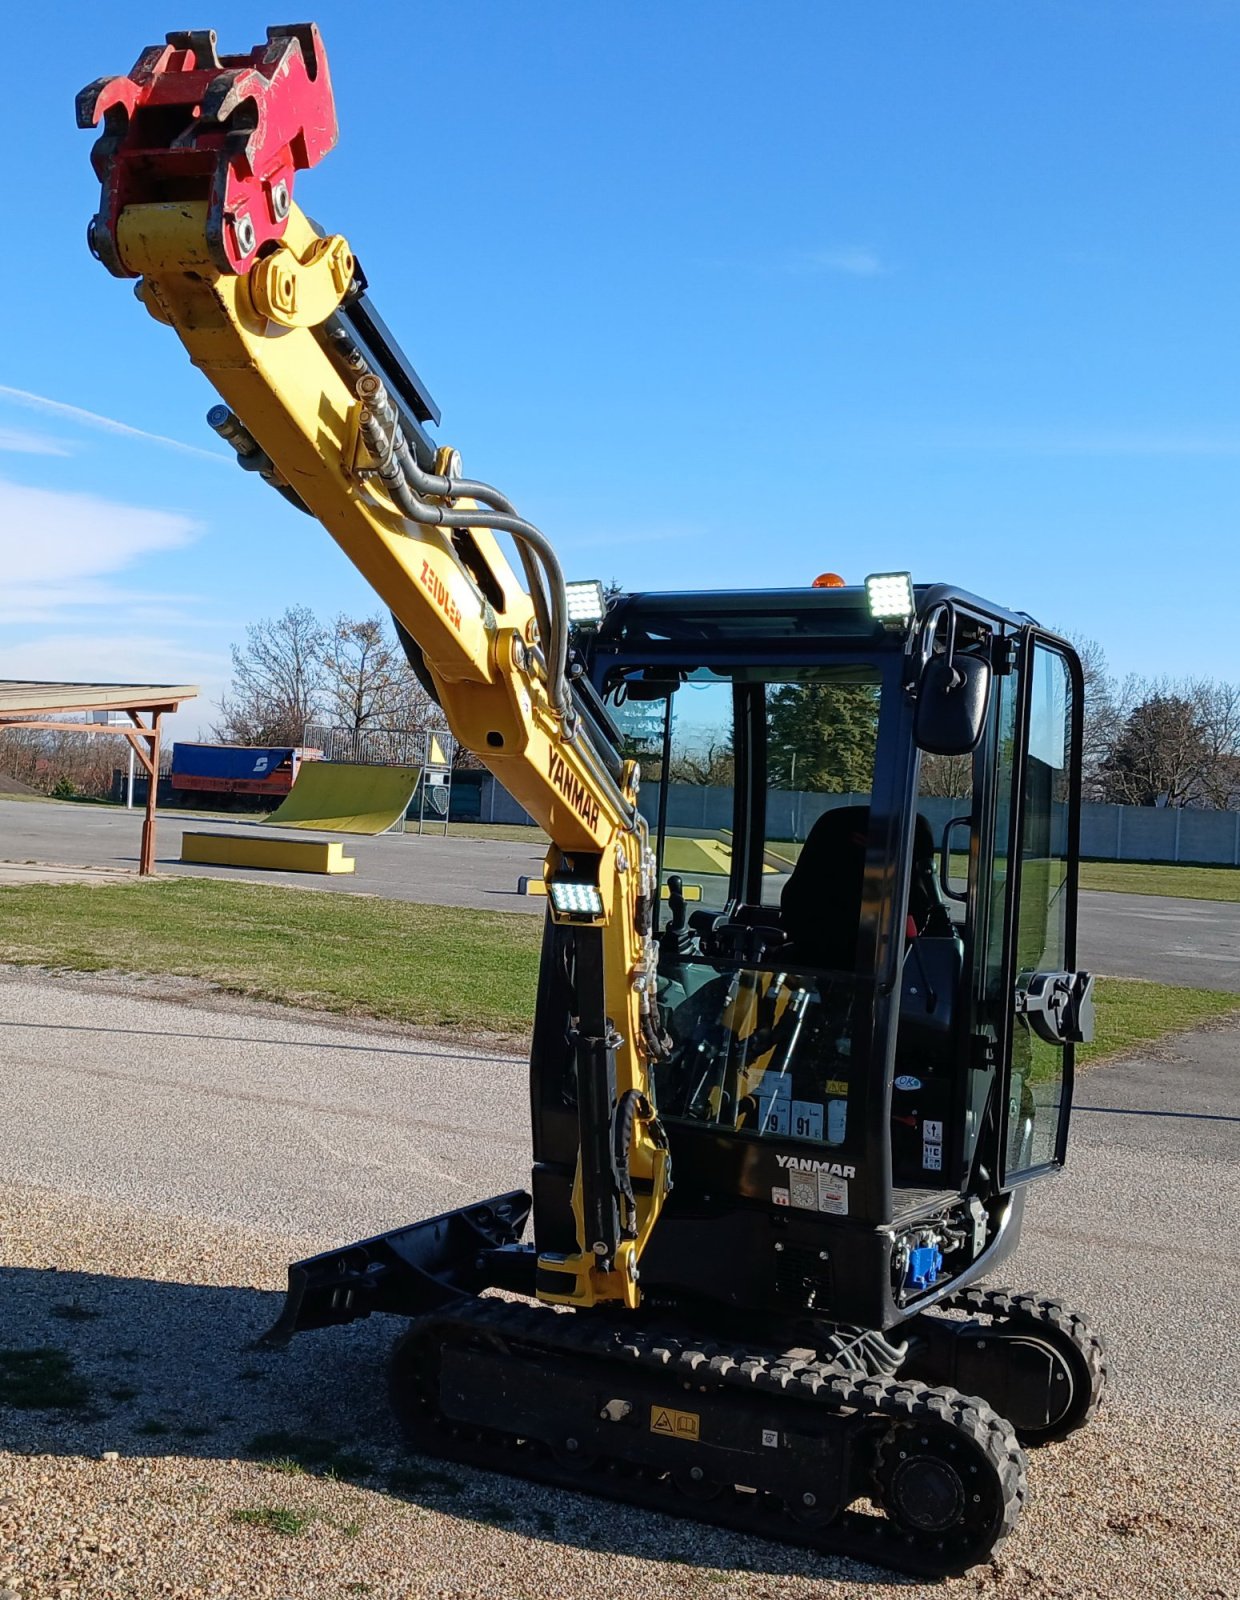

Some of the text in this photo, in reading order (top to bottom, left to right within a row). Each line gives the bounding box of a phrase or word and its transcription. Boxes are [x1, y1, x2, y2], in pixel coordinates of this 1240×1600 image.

[547, 743, 600, 834] YANMAR
[797, 1117, 810, 1137] 91
[775, 1154, 856, 1179] YANMAR
